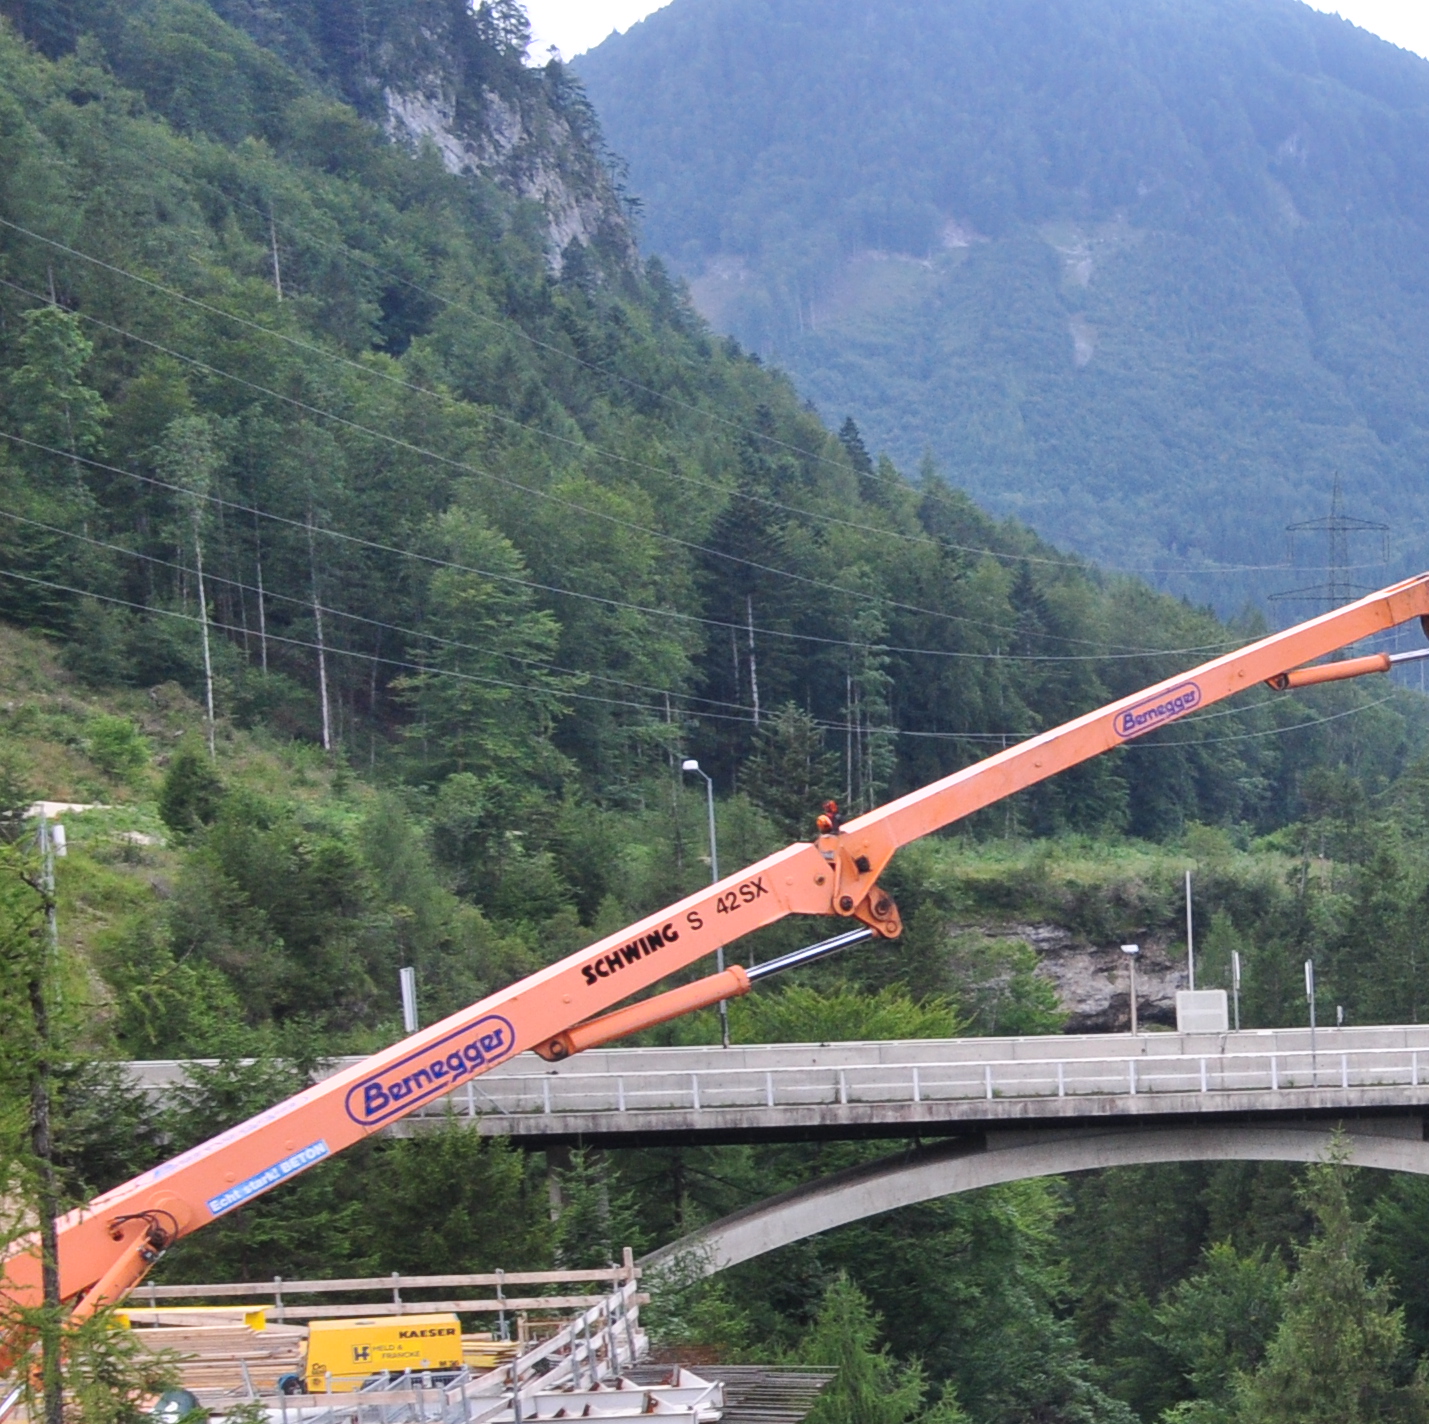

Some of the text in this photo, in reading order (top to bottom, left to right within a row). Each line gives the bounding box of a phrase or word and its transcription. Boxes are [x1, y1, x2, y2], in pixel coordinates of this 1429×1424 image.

[1123, 690, 1196, 732] Bernegger
[581, 922, 680, 986] SCHWING
[686, 911, 704, 930] S
[364, 1028, 504, 1117] Bernegger
[208, 1189, 241, 1213] Echt
[280, 1142, 326, 1174] BETON
[399, 1328, 456, 1339] KAESER
